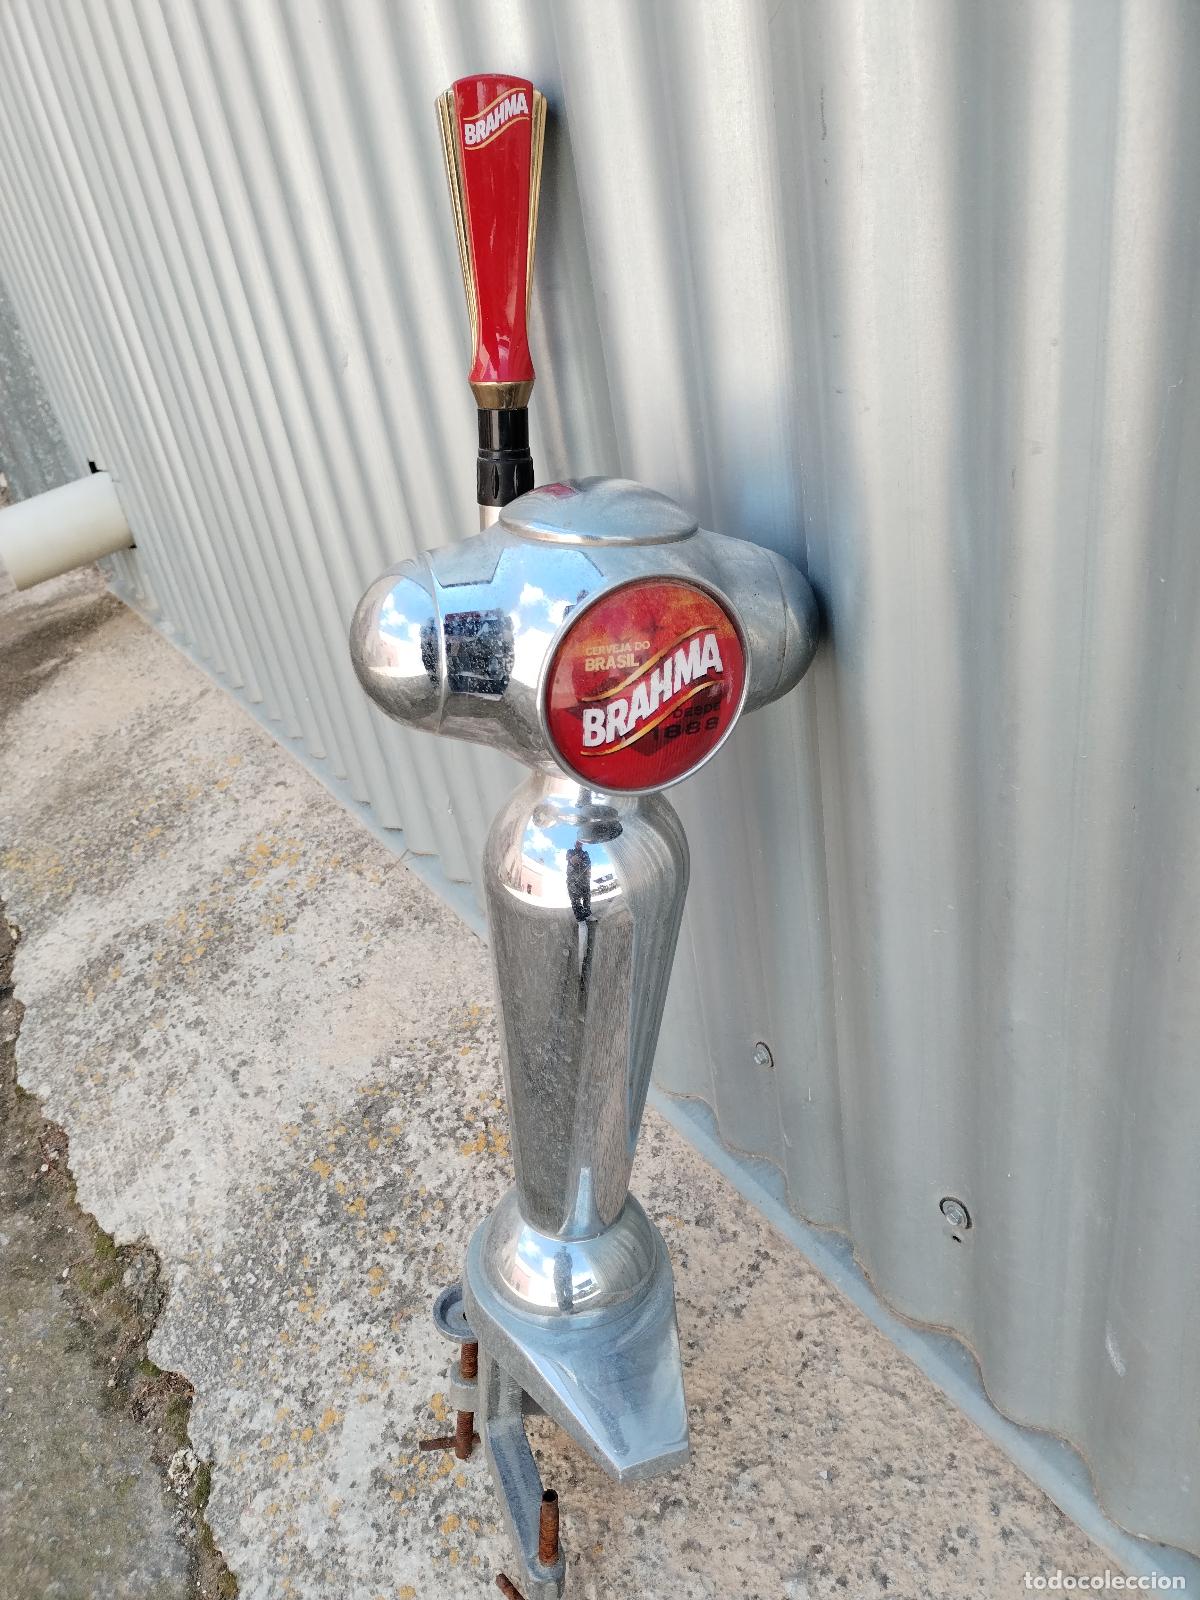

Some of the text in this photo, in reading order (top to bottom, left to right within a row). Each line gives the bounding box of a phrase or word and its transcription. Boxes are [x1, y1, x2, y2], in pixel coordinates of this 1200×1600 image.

[464, 92, 528, 145] BRAHMA
[584, 653, 640, 672] BRASIL
[585, 640, 650, 655] CERVEJA DO
[583, 633, 723, 747] BRAHMA
